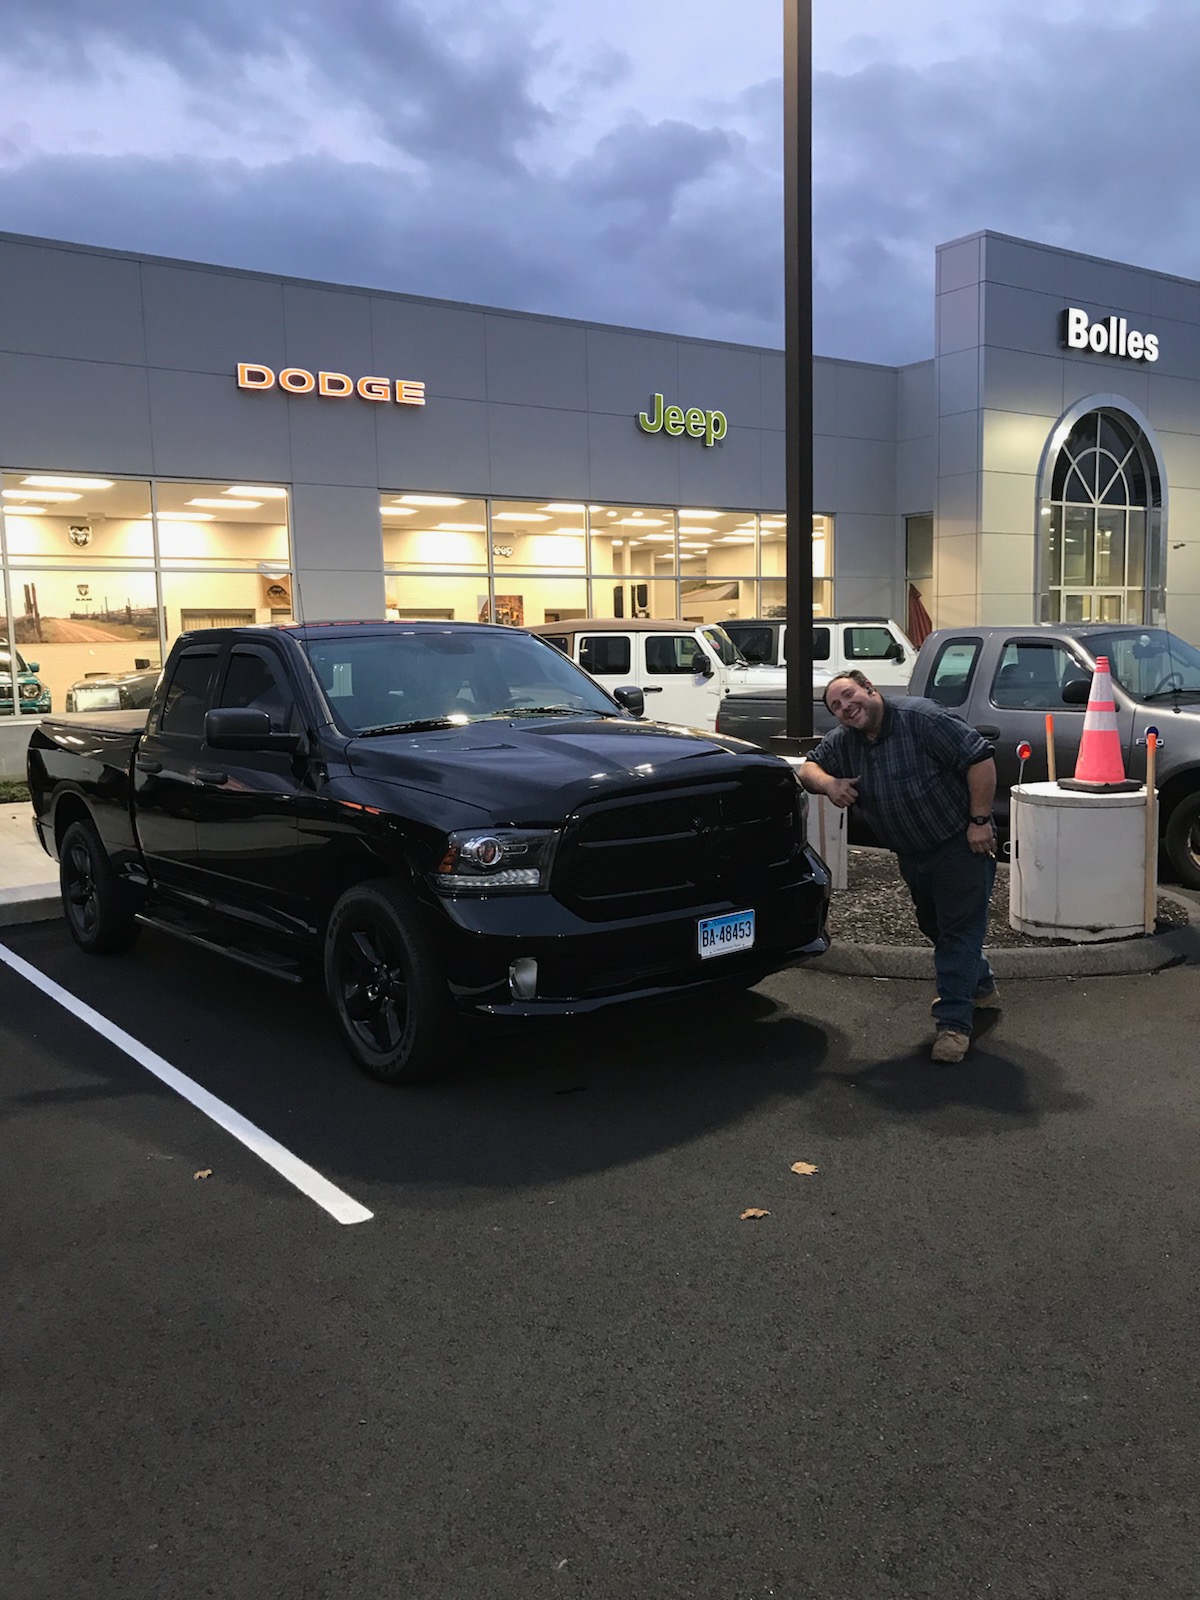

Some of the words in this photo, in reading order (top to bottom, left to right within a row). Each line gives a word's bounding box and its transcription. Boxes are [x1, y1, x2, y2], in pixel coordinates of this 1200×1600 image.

[1067, 307, 1159, 362] Bolles
[237, 362, 426, 406] DODGE
[638, 392, 728, 447] Jeep
[491, 543, 513, 558] eep
